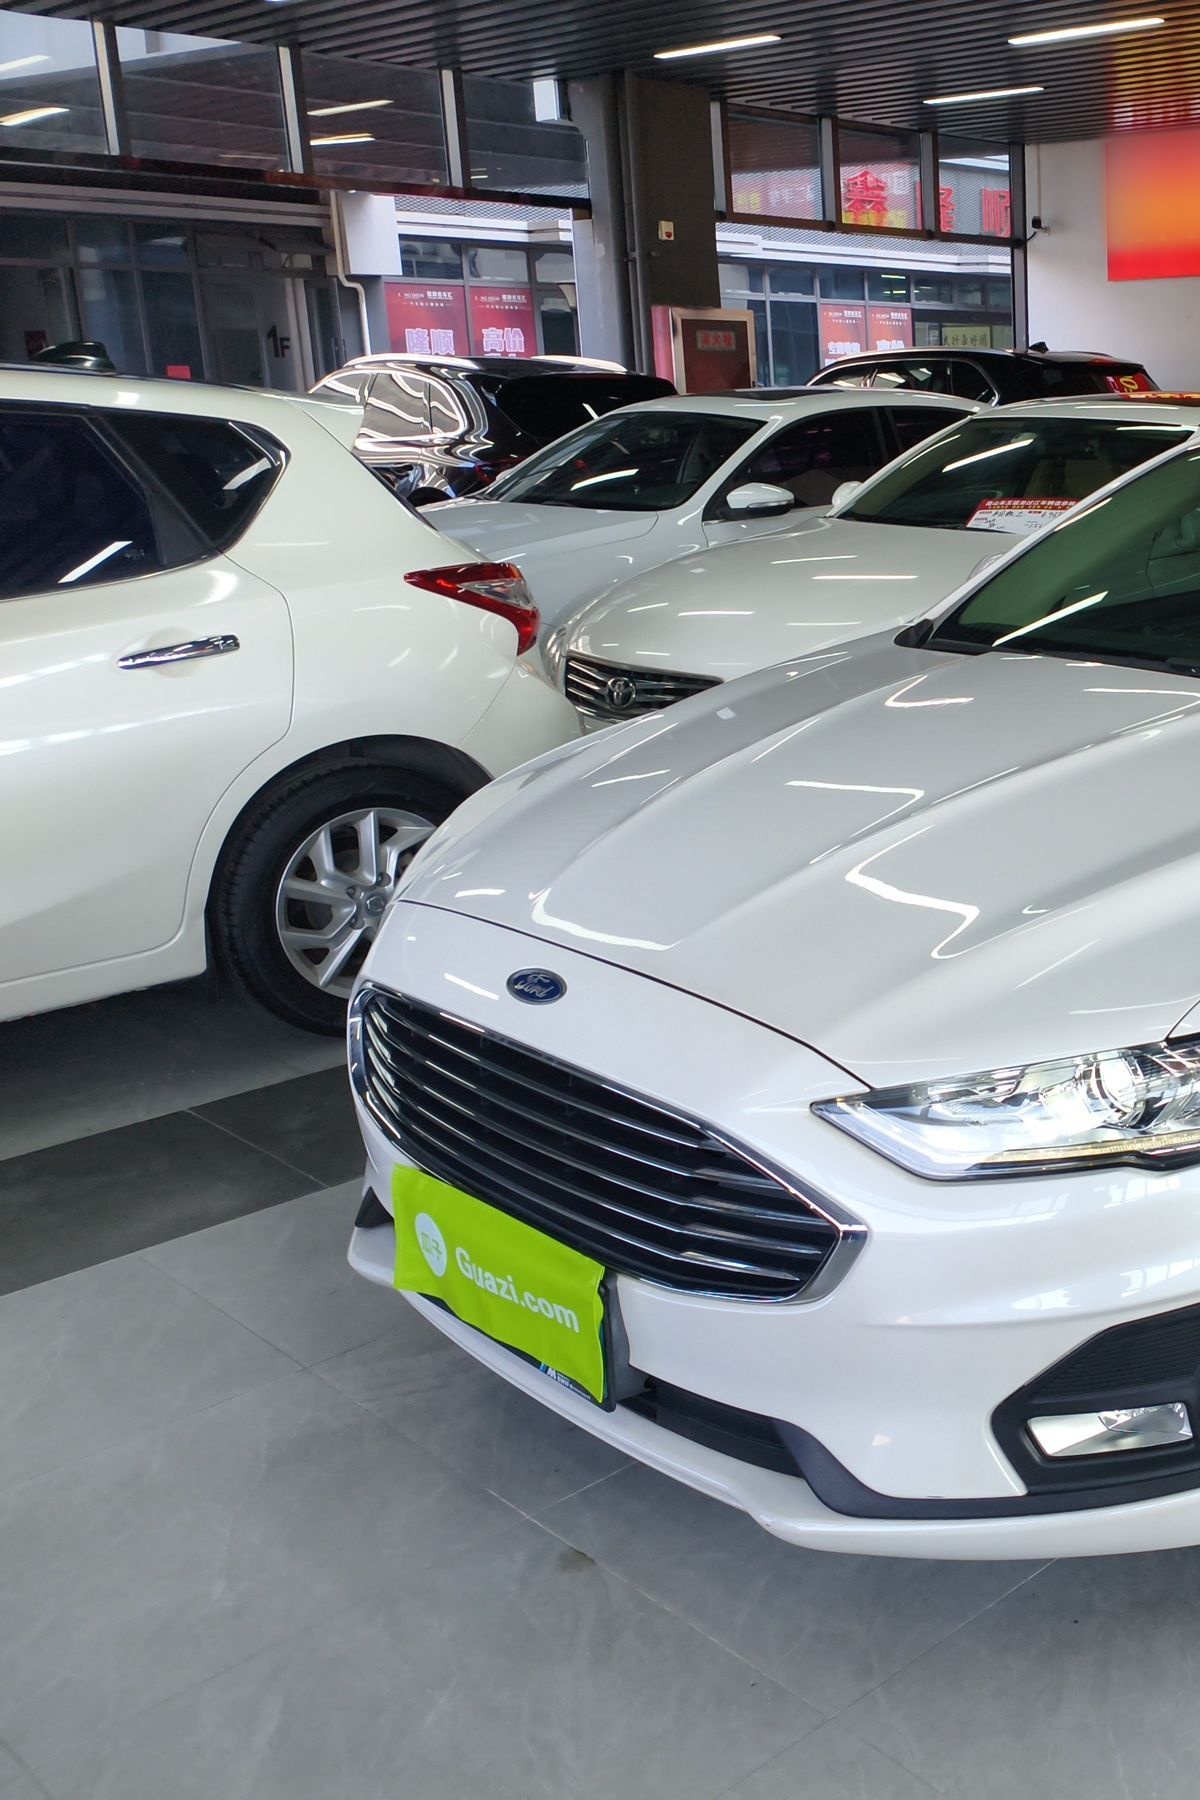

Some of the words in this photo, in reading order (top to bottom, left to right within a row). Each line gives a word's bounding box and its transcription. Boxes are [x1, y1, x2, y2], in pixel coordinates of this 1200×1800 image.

[267, 325, 290, 358] 1F
[405, 328, 456, 355] 隆顺
[482, 327, 525, 352] 高价
[514, 973, 554, 998] Ford
[420, 1231, 443, 1261] 瓜子
[455, 1246, 580, 1334] Guazi.com
